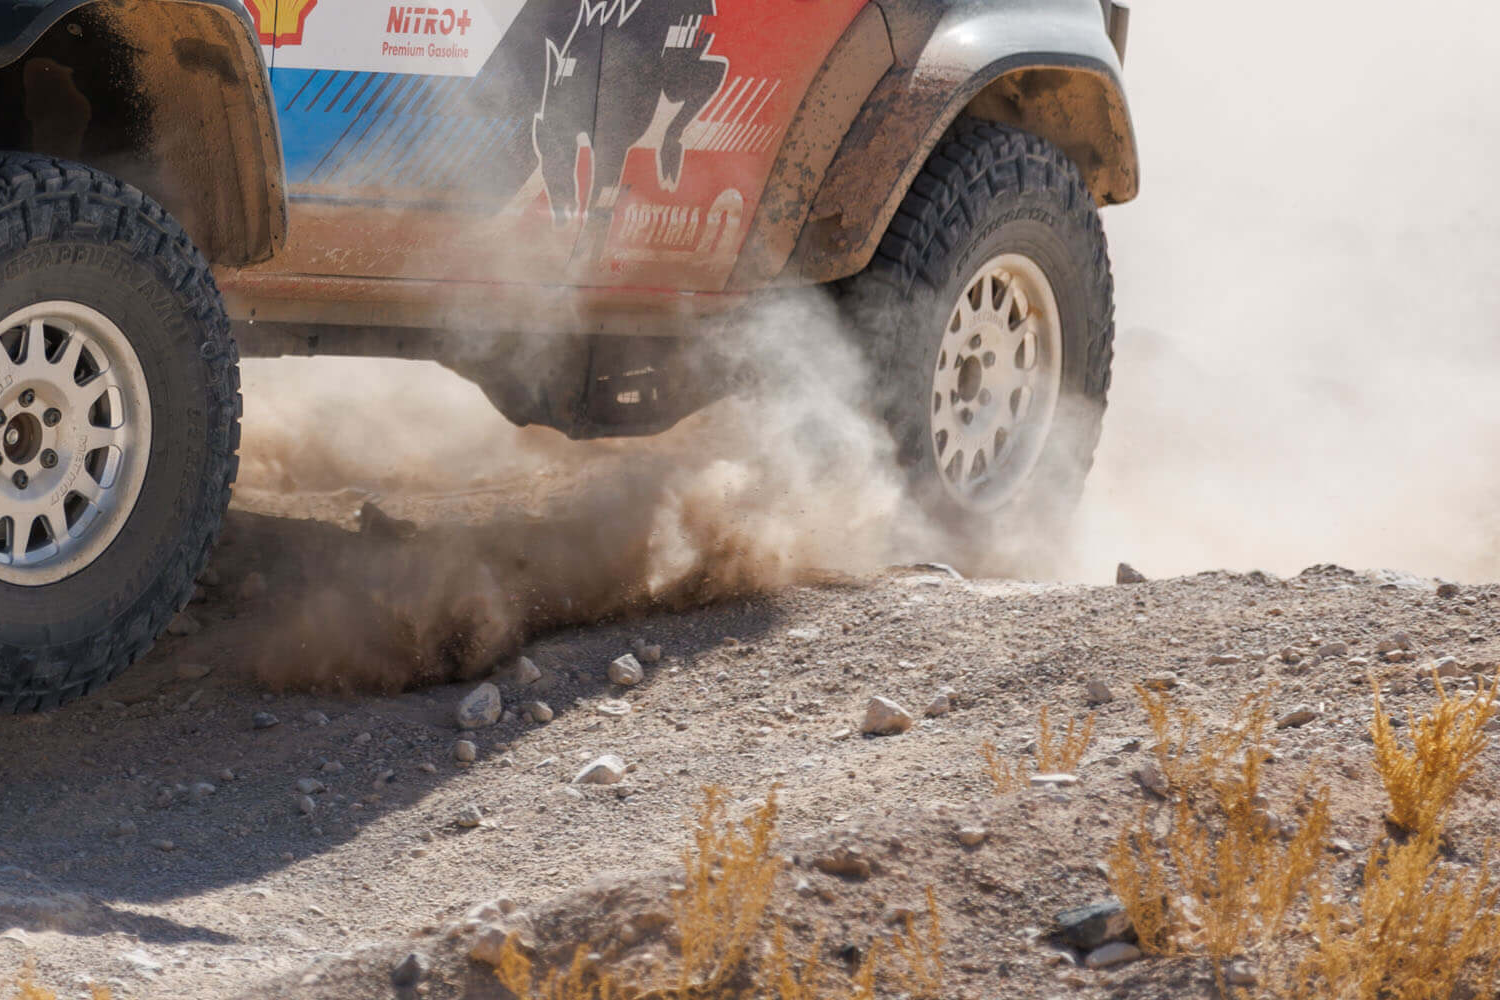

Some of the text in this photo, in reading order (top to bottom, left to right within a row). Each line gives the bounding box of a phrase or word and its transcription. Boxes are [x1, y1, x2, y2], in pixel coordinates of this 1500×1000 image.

[382, 41, 469, 58] Premium Gasoline
[619, 203, 700, 247] OPTIMA
